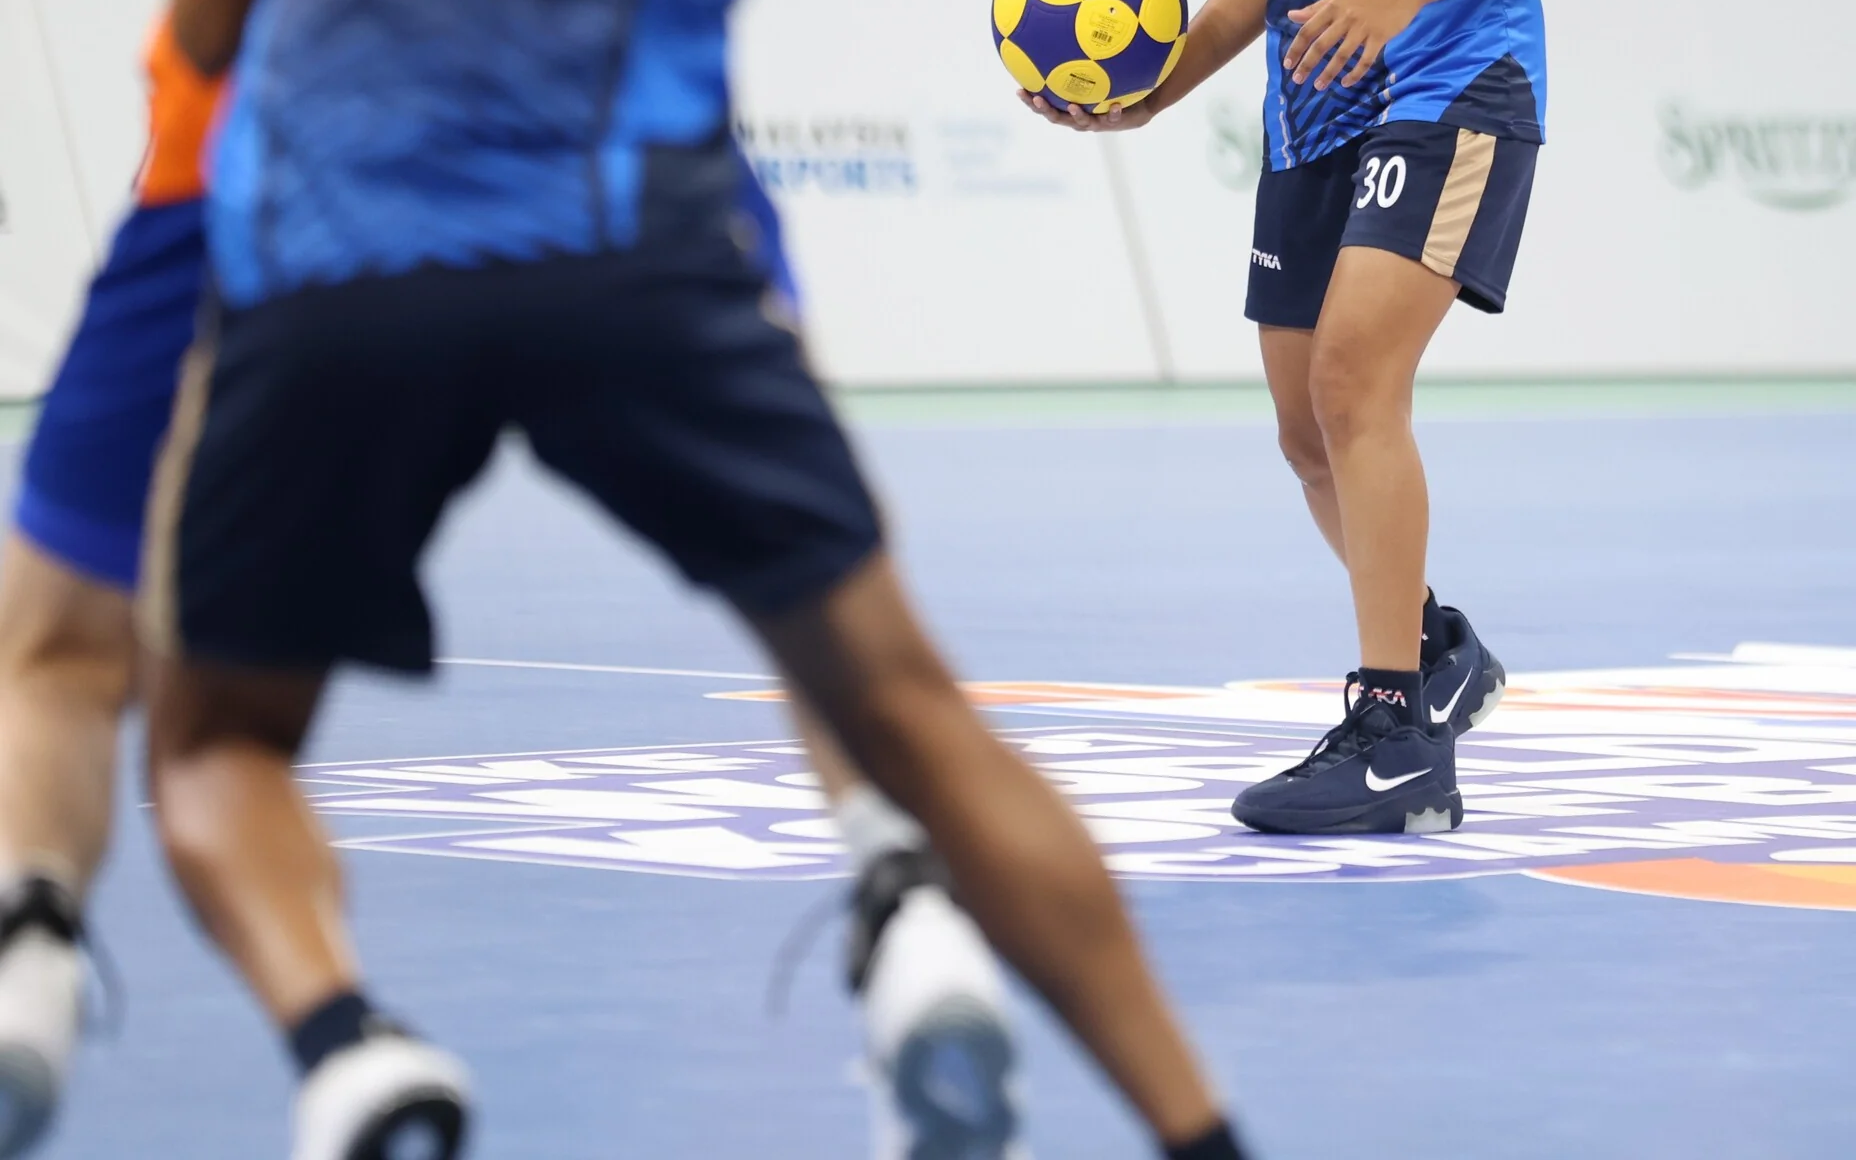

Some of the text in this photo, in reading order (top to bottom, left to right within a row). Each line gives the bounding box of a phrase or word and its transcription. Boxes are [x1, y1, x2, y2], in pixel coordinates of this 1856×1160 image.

[1356, 155, 1407, 209] 30
[1252, 248, 1281, 270] TYKA
[317, 752, 777, 786] IKF
